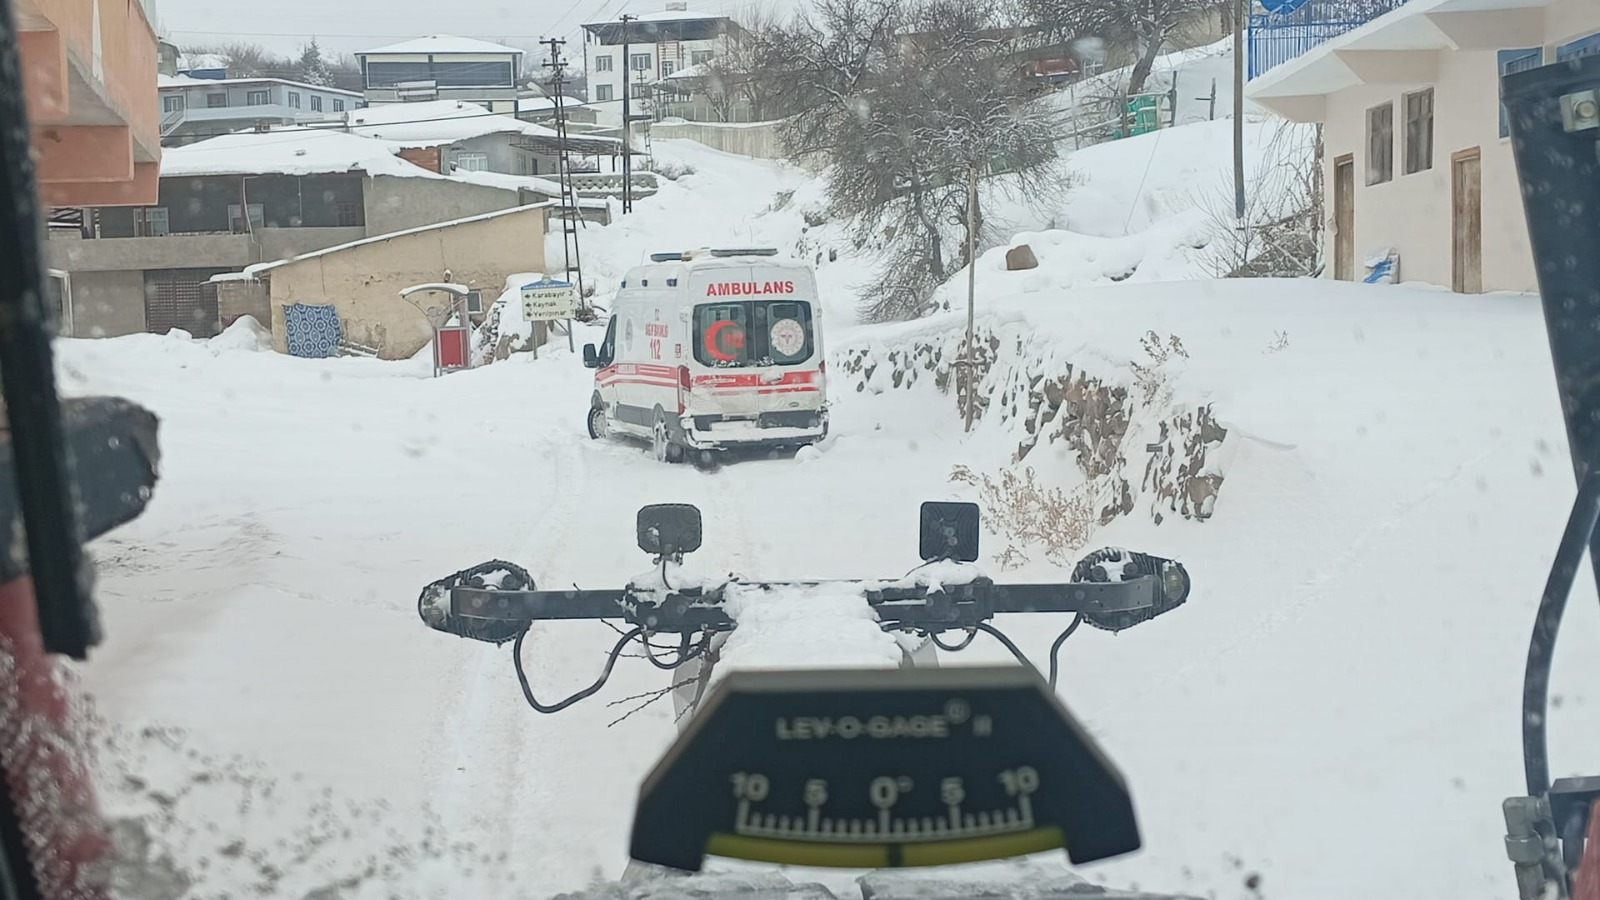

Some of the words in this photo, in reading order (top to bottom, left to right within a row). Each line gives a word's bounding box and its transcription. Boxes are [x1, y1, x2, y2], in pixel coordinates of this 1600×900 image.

[706, 281, 795, 296] AMBULANS
[650, 338, 661, 360] 112
[730, 772, 769, 801] 10
[804, 778, 828, 807] 5
[941, 776, 965, 806] 5
[998, 765, 1040, 796] 10
